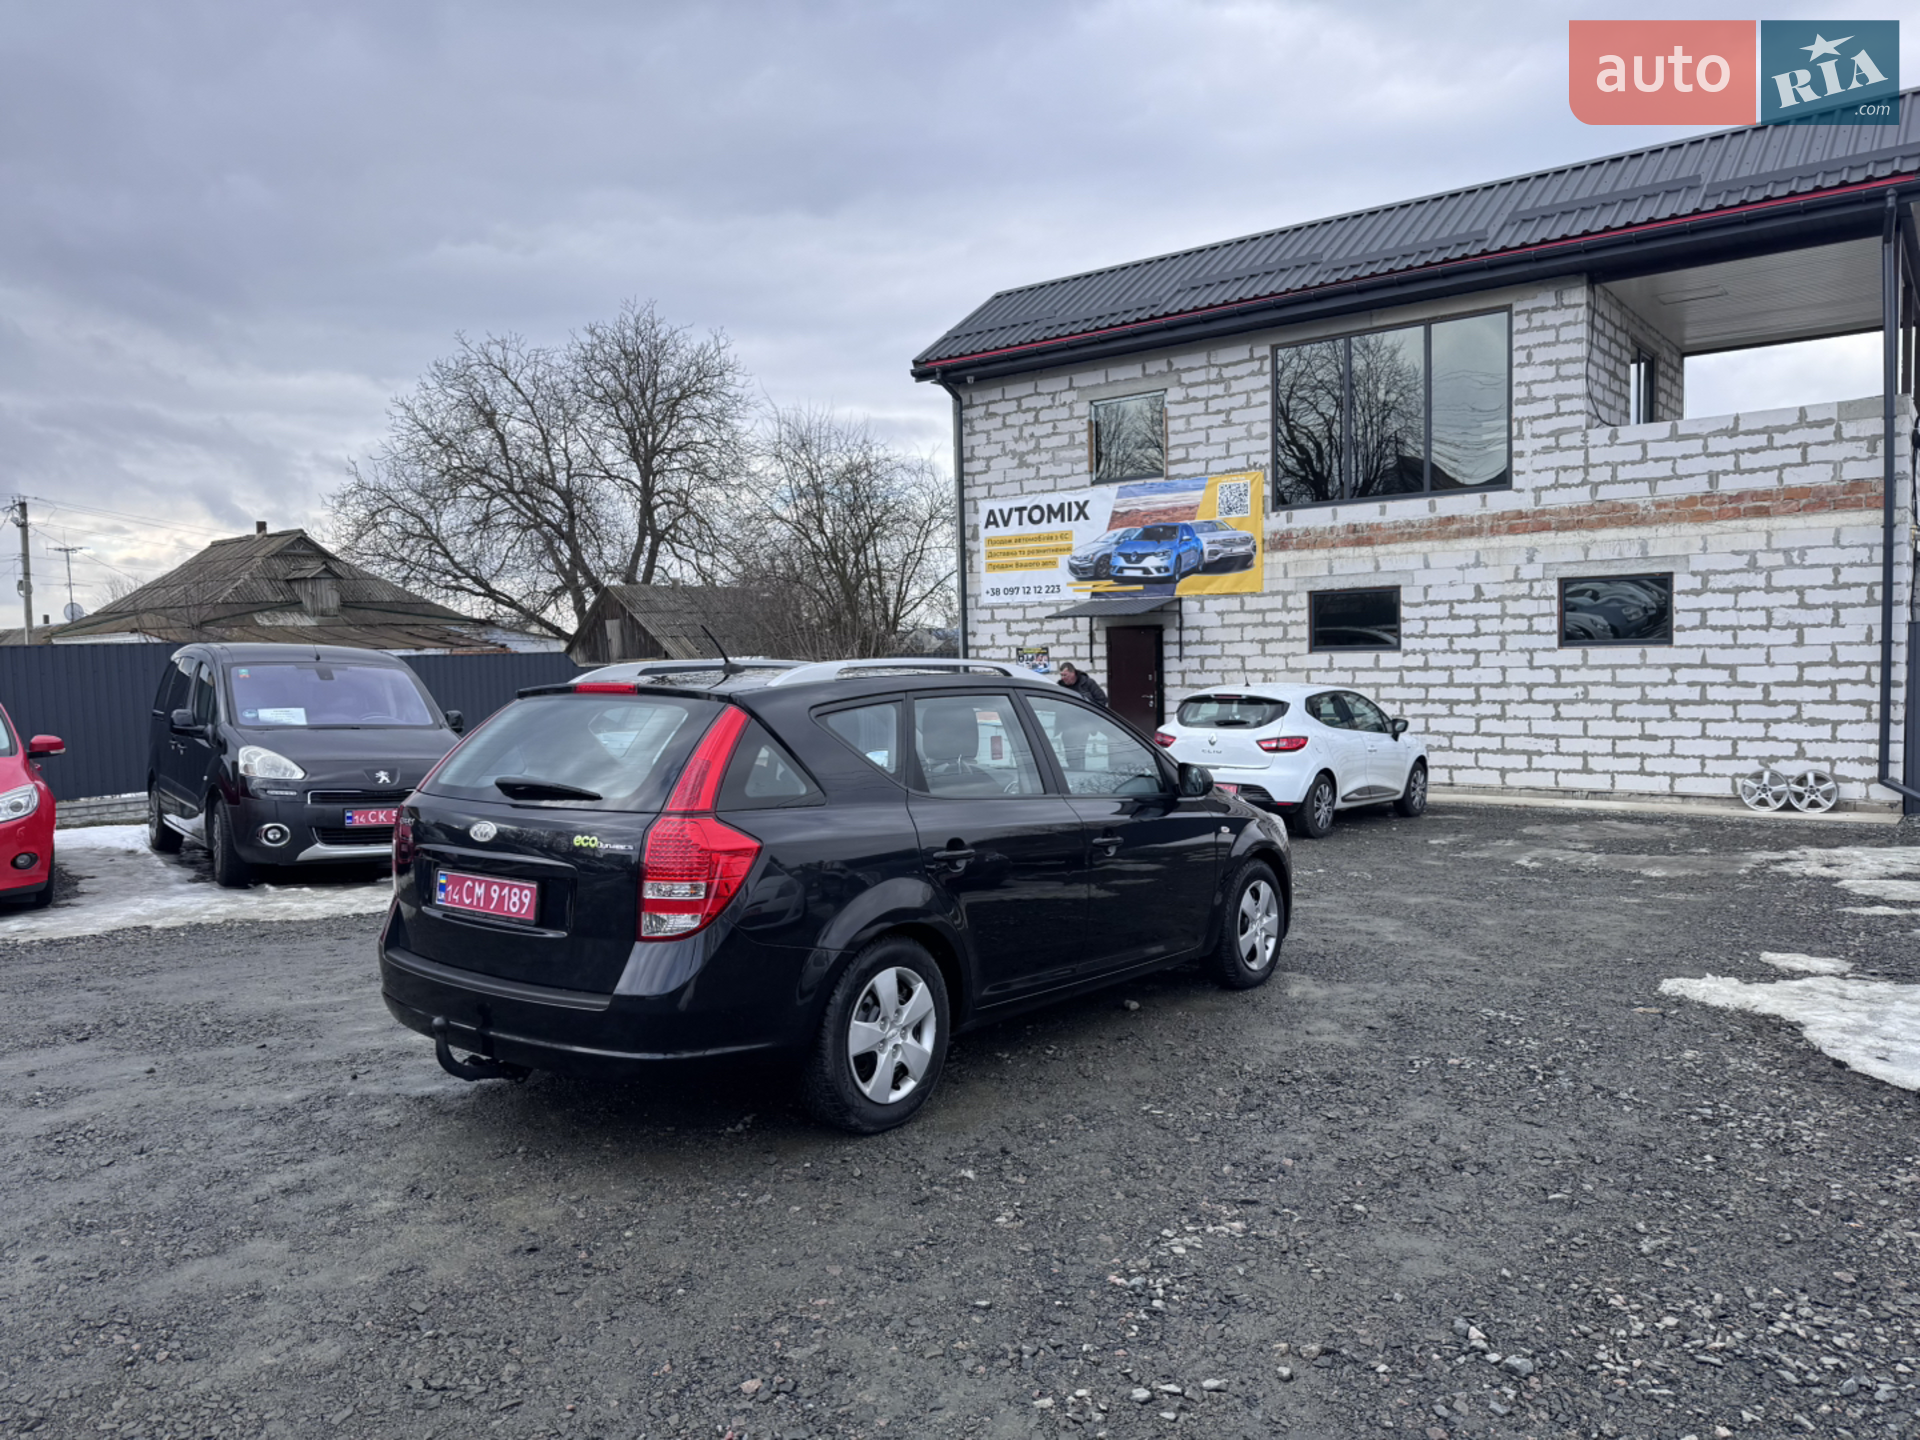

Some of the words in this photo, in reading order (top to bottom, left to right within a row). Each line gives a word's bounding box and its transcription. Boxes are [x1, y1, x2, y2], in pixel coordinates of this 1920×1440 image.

[984, 500, 1090, 529] AVTOMIX
[985, 587, 1001, 597] +38
[1003, 586, 1020, 595] 097
[1021, 585, 1032, 595] 12
[1033, 585, 1043, 595] 12
[1045, 584, 1061, 594] 223
[368, 810, 388, 823] CK
[446, 884, 460, 903] 14
[462, 880, 486, 908] CM
[489, 884, 531, 915] 9189
